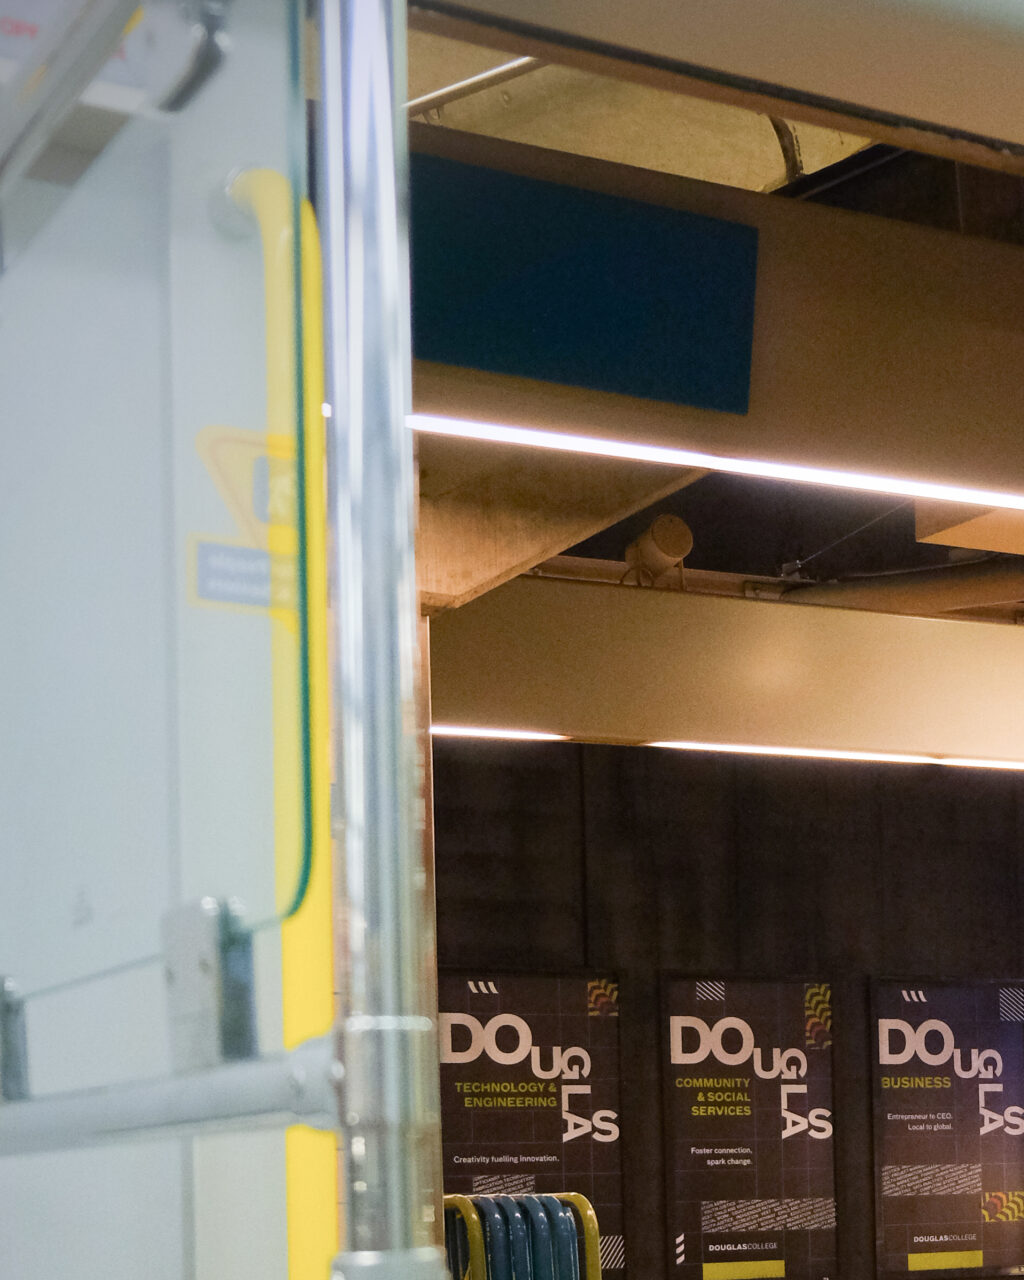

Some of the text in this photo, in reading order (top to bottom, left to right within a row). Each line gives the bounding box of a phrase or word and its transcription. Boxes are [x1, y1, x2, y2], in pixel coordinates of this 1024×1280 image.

[438, 1012, 620, 1143] DOUGLAS
[670, 1016, 833, 1140] DOUGLAS
[675, 1078, 750, 1088] COMMUNITY
[881, 1076, 951, 1089] BUSINESS
[455, 1082, 557, 1093] TECHNOLOGY &
[464, 1096, 557, 1108] ENGINEERING
[697, 1091, 751, 1102] & SOCIAL
[691, 1106, 751, 1116] SERVICES
[887, 1112, 953, 1122] Entrepreneur to CEO.
[908, 1122, 953, 1132] Local to global.
[691, 1147, 713, 1155] Foster
[453, 1154, 560, 1165] Creativity fuelling innovation.
[707, 1158, 753, 1167] spark change.
